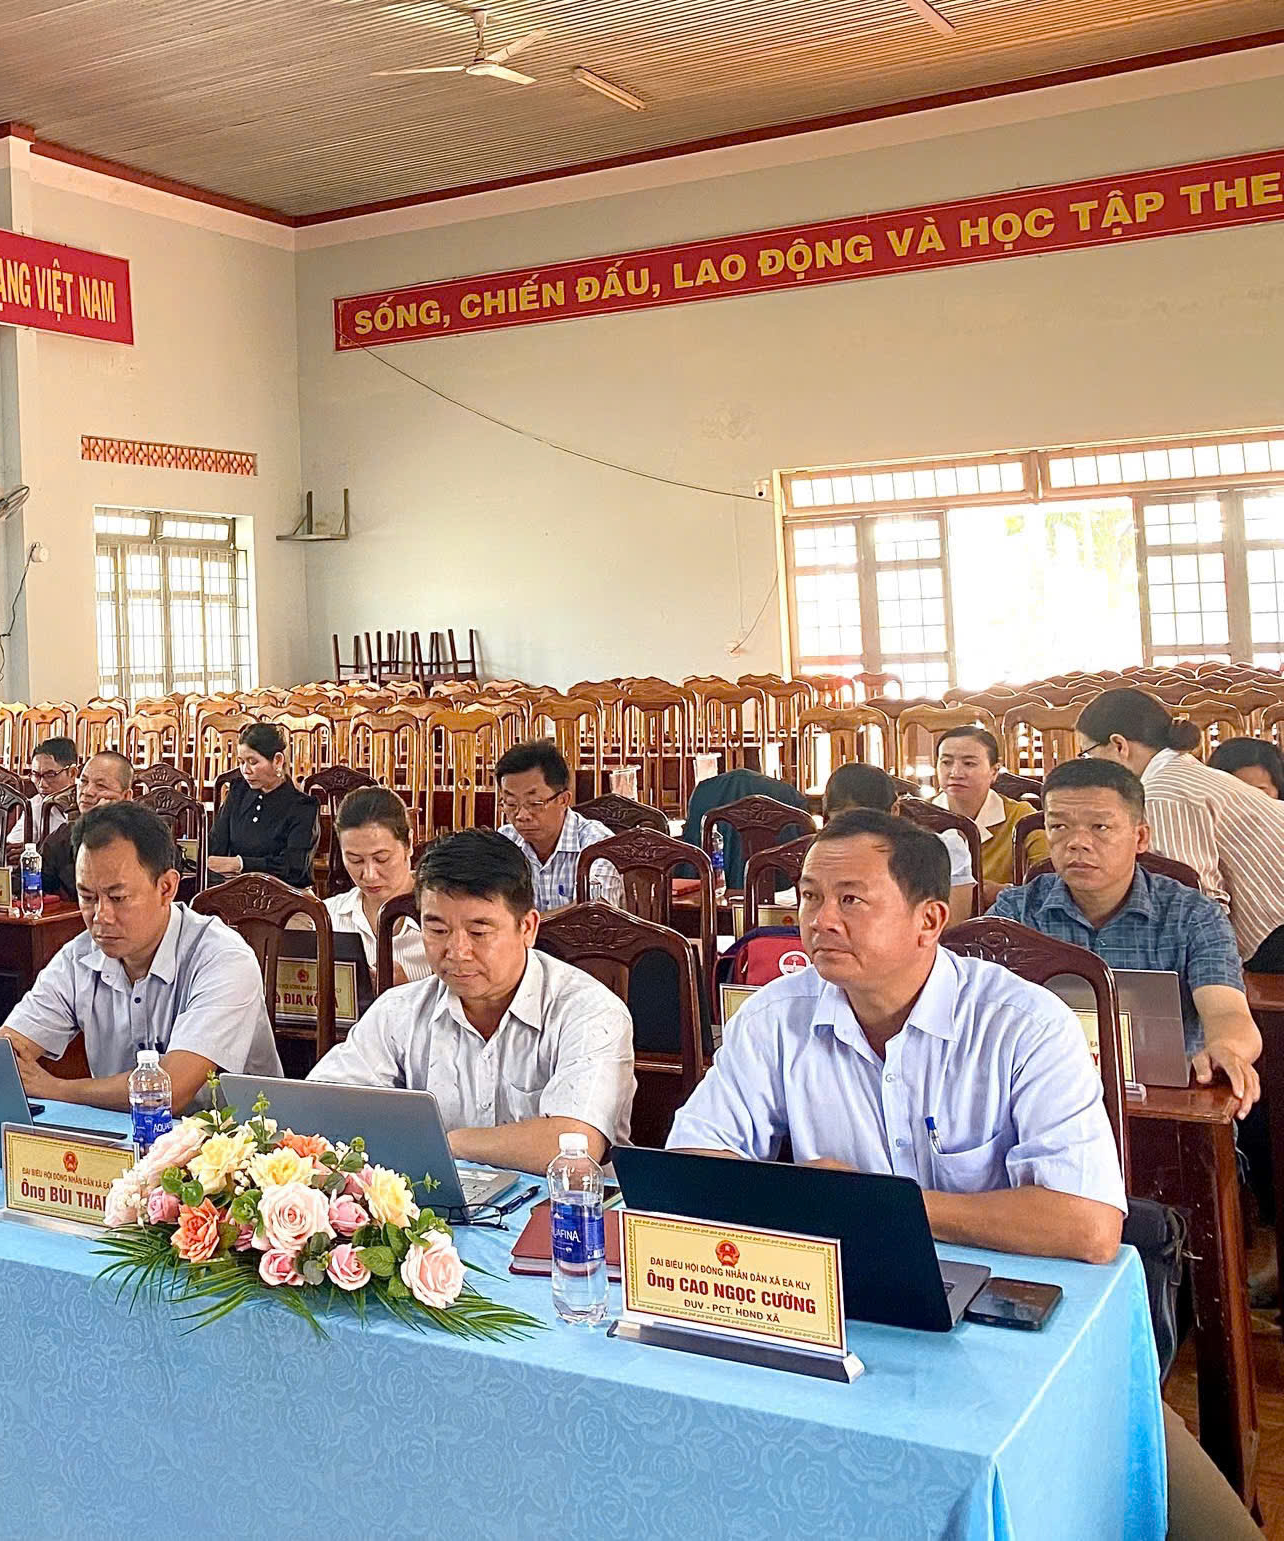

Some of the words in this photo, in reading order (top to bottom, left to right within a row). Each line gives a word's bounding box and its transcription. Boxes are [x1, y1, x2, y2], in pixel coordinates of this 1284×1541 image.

[354, 296, 451, 335] SỐNG,
[460, 273, 565, 319] CHIẾN
[575, 260, 662, 303] ĐẤU,
[673, 254, 747, 289] LAO
[757, 235, 873, 280] ĐỘNG
[886, 217, 946, 257] VÀ
[959, 208, 1055, 250] HỌC
[1070, 190, 1164, 235] TẬP
[1180, 172, 1282, 216] THE
[35, 259, 73, 328] VIỆT
[79, 276, 115, 323] NAM
[21, 1177, 46, 1202] Ông
[50, 1184, 73, 1206] BÙI
[76, 1191, 107, 1212] THA
[647, 1268, 675, 1292] Ông
[679, 1276, 709, 1296] CAO
[713, 1282, 756, 1306] NGỌC
[761, 1290, 817, 1315] CƯỜNG
[685, 1261, 699, 1273] HỘI
[700, 1264, 724, 1277] ĐỒNG
[725, 1267, 748, 1281] NHÂN
[750, 1271, 767, 1284] DÂN
[769, 1275, 781, 1286] XÃ
[782, 1278, 794, 1288] EA
[795, 1279, 811, 1291] KLY
[683, 1298, 704, 1310] ĐUV
[766, 1312, 781, 1324] XÃ
